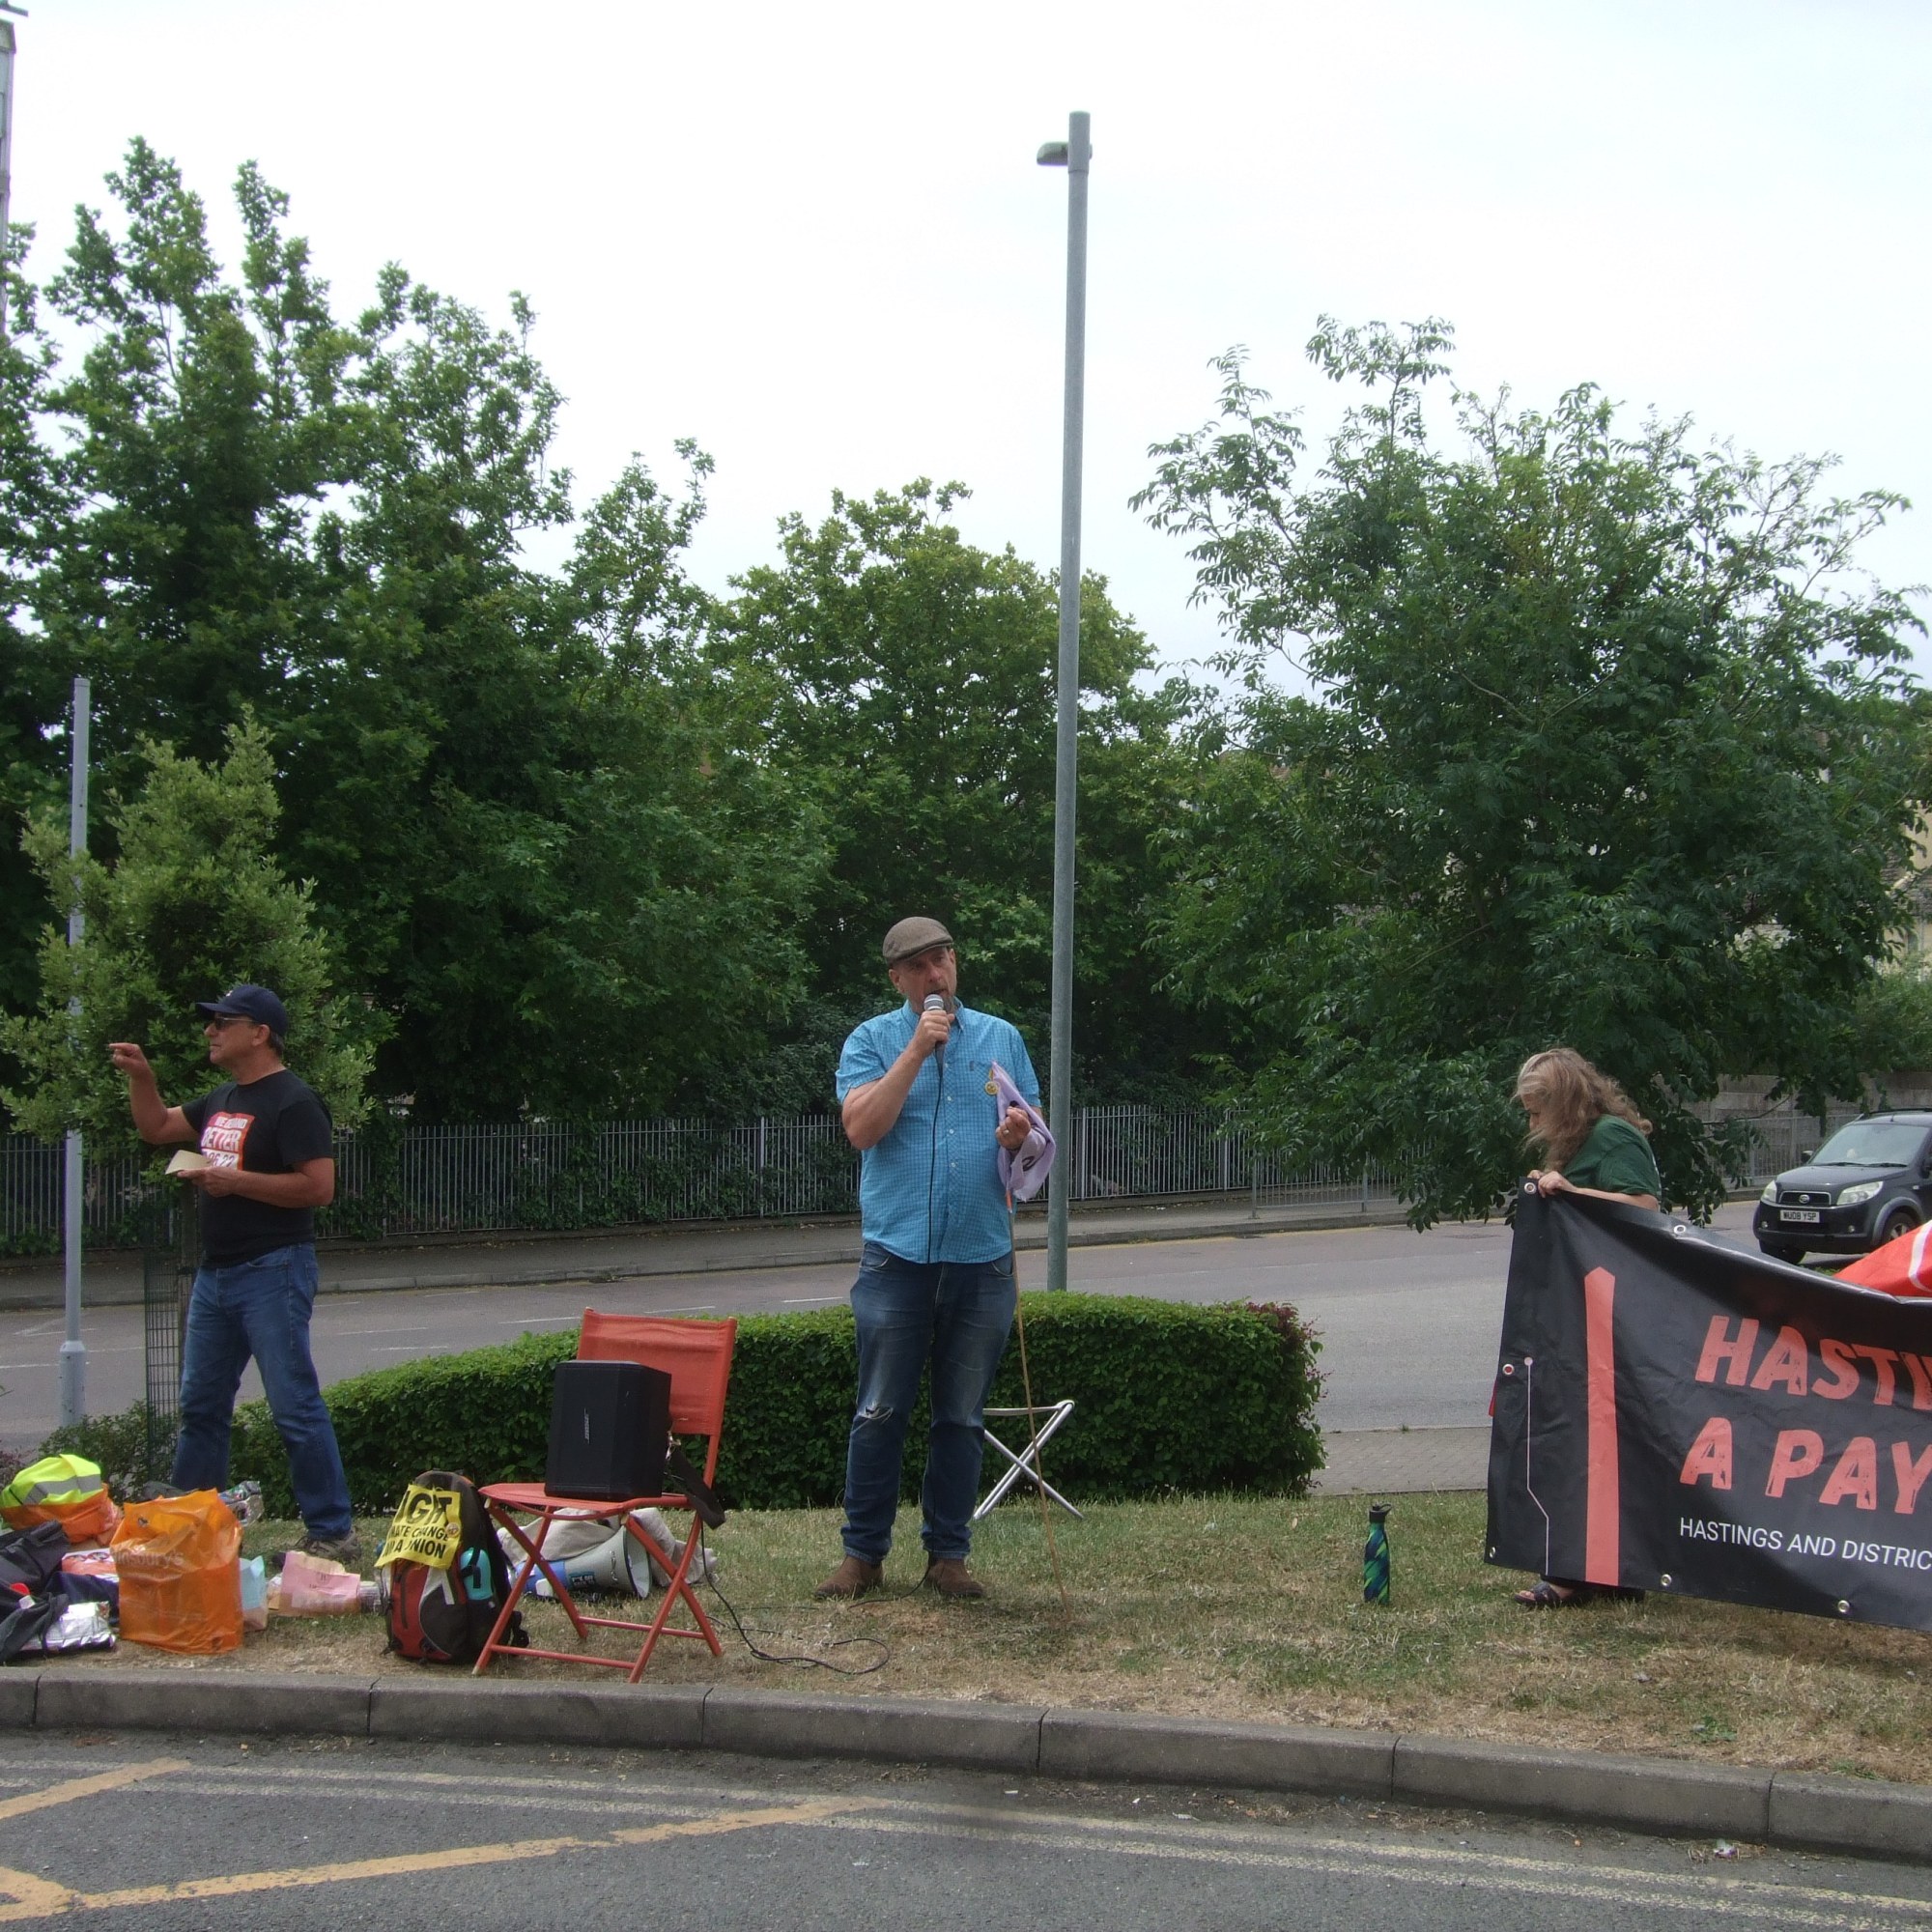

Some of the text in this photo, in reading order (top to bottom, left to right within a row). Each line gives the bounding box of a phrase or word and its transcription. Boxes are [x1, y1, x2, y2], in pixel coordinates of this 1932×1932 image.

[201, 1126, 242, 1151] BETTER
[1695, 1315, 1932, 1410] HASTI
[1679, 1417, 1932, 1515] A PAY
[1680, 1517, 1932, 1571] HASTINGS AND DISTRIC
